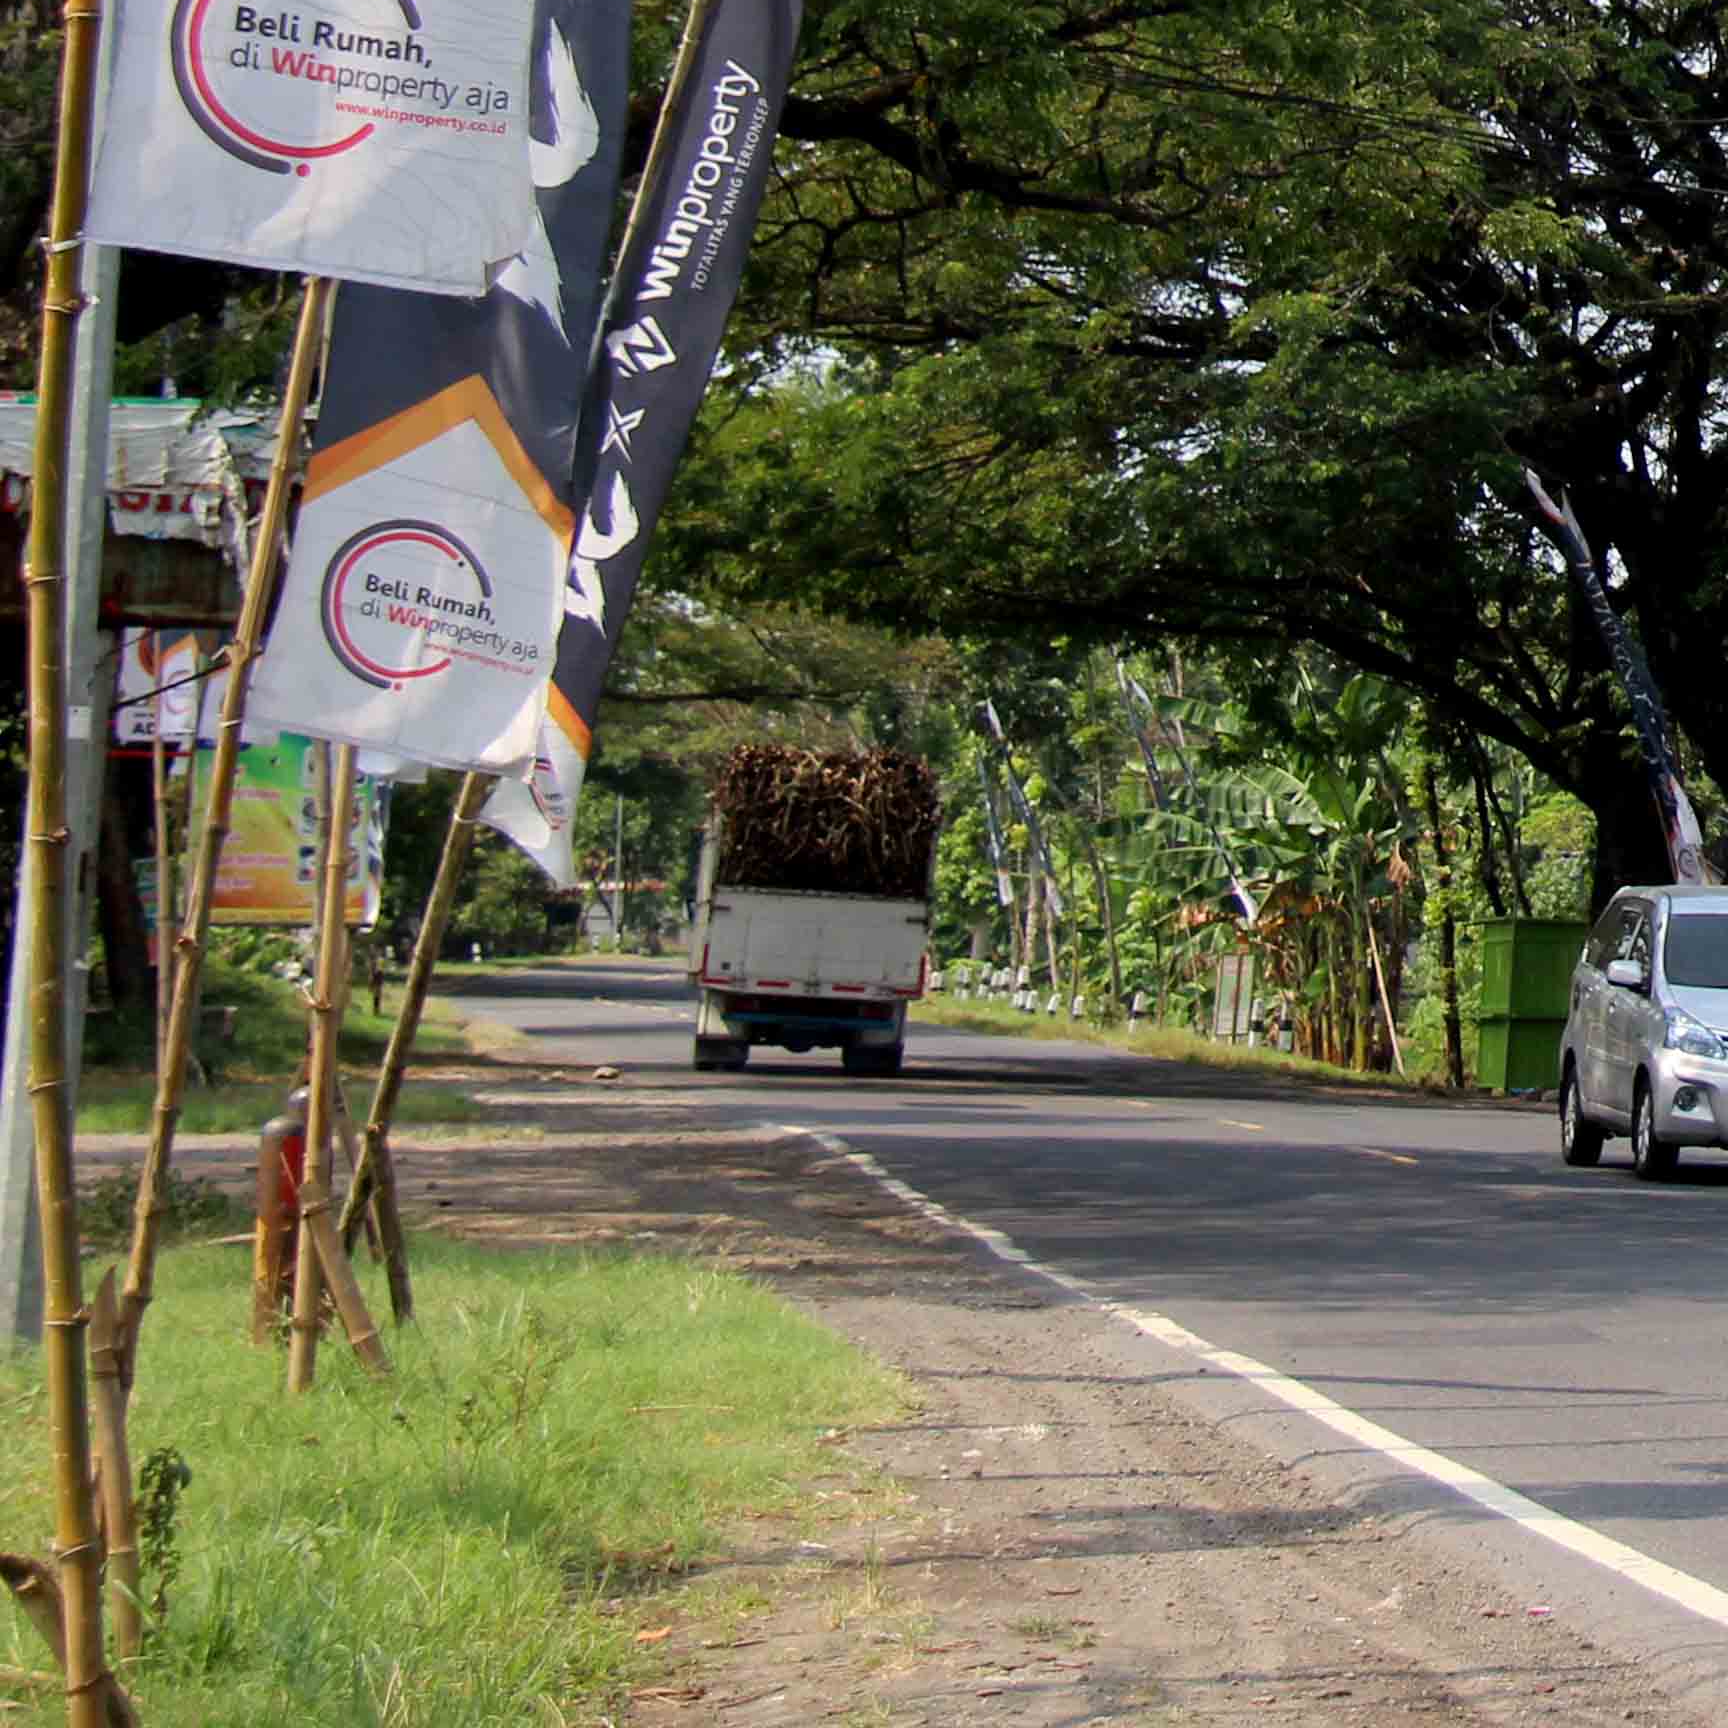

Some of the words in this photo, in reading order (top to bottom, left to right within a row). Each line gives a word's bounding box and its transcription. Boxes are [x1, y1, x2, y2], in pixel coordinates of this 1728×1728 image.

[234, 5, 300, 43] Beli
[312, 20, 433, 69] Rumah,
[229, 41, 260, 72] di
[270, 46, 460, 110] Winproperty
[464, 81, 510, 116] aja
[335, 101, 509, 135] www.winproperty.co.id
[636, 58, 761, 302] Winproperty
[690, 210, 729, 292] TOTALITAS
[721, 172, 744, 213] YANG
[736, 96, 770, 173] TERKONSEP
[359, 598, 381, 619] di
[387, 602, 511, 656] Winproperty
[510, 638, 540, 663] aja
[364, 572, 410, 602] Beli
[415, 586, 497, 626] Rumah,
